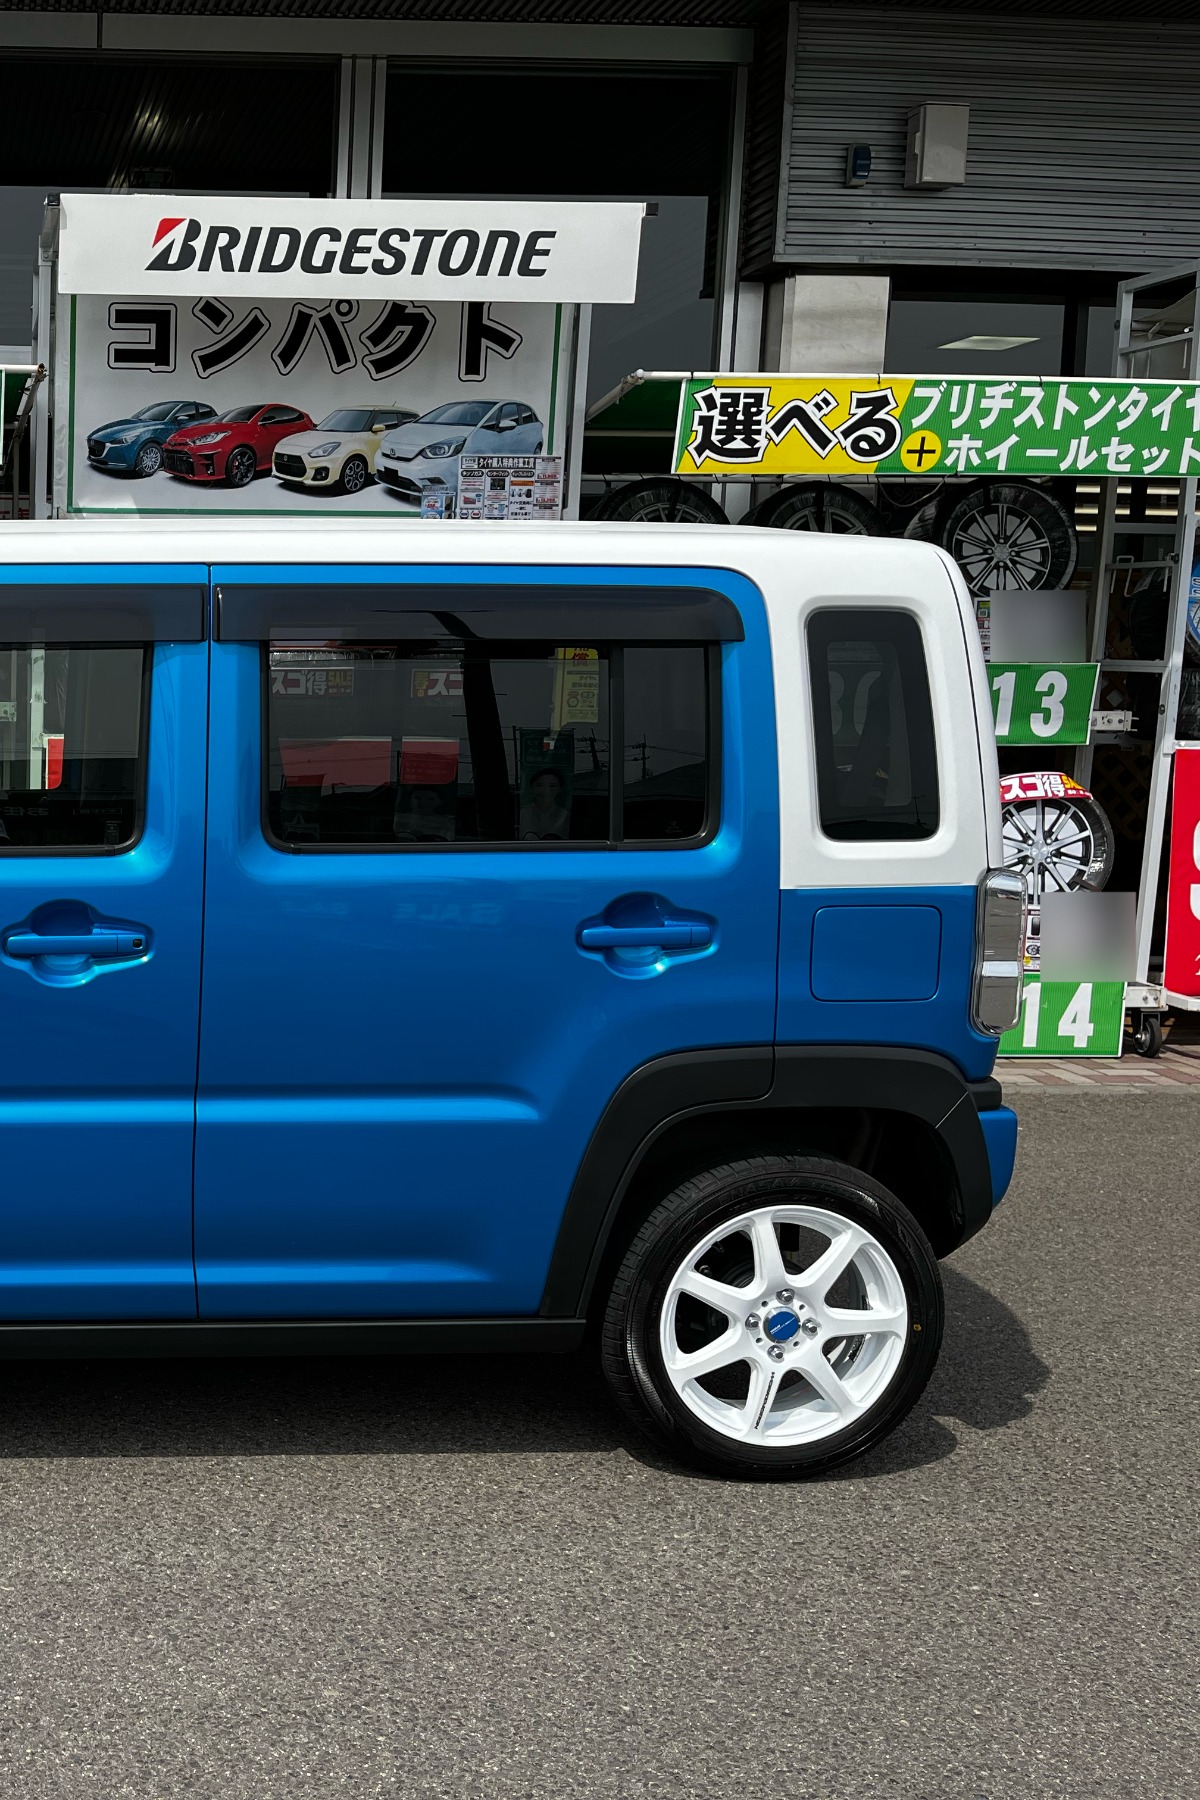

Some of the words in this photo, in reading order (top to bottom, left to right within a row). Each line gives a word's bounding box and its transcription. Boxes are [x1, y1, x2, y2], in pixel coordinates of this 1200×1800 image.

[145, 217, 557, 278] BRIDGESTONE
[107, 298, 523, 382] コンパクト
[687, 386, 902, 470] 選べる
[992, 670, 1068, 738] 13
[1000, 774, 1065, 800] スゴ得
[1022, 982, 1094, 1048] 14
